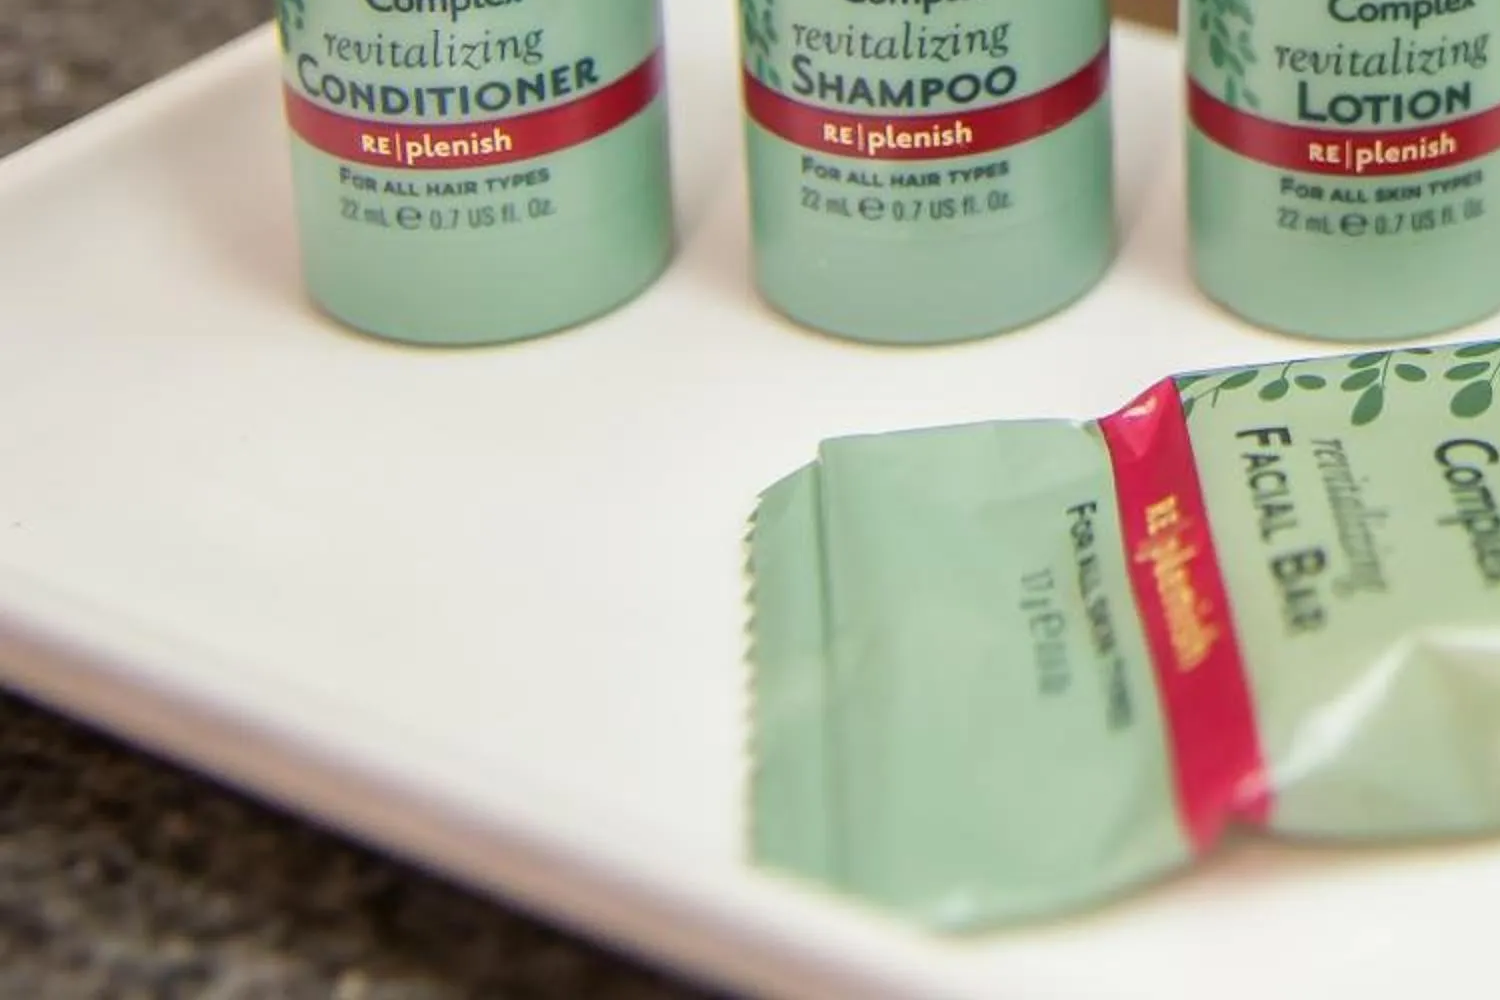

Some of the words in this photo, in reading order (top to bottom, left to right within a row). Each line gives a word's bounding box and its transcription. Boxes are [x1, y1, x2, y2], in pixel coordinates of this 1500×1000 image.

[324, 28, 544, 69] revitalizing
[792, 21, 1011, 61] revitalizing
[1274, 32, 1491, 78] revitalizing
[297, 54, 599, 116] CONDITIONER
[791, 54, 1018, 108] SHAMPOO
[1297, 79, 1472, 125] LOTION
[1235, 427, 1297, 544] FACIAL
